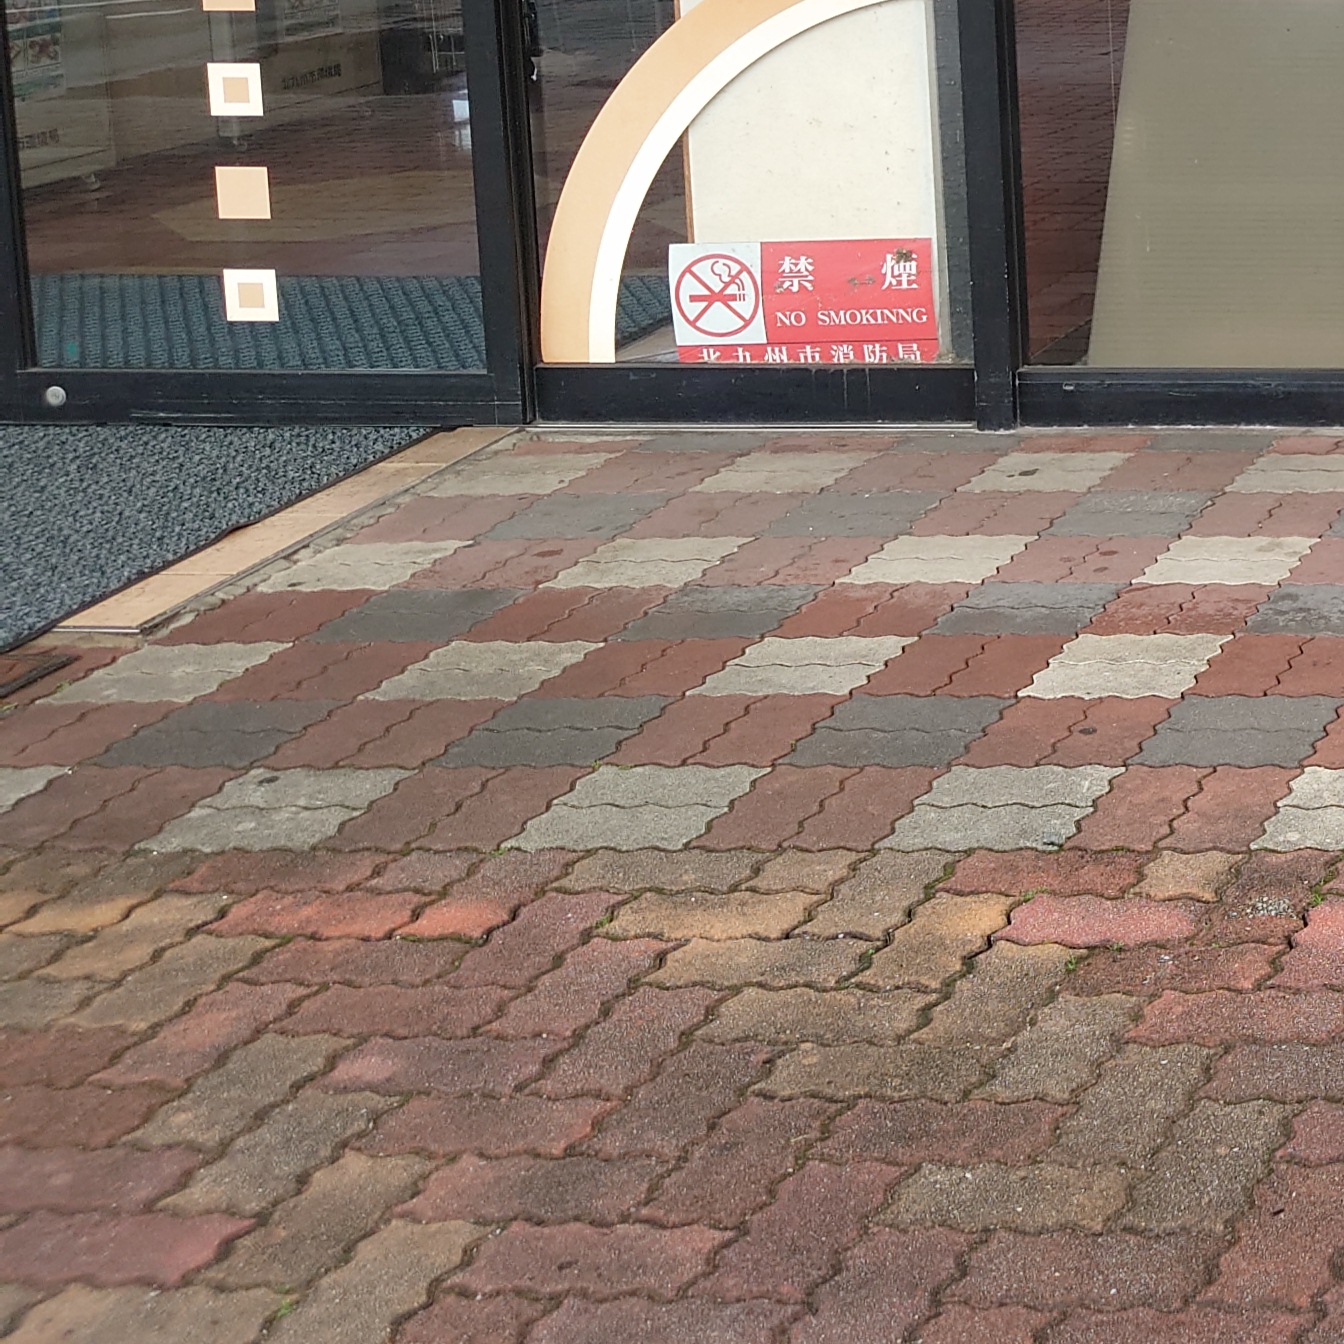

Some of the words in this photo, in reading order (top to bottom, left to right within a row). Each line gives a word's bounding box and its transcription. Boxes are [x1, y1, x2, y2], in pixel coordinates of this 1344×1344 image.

[778, 253, 919, 293] 禁煙
[776, 310, 807, 327] NO
[817, 307, 928, 327] SMOKINNG
